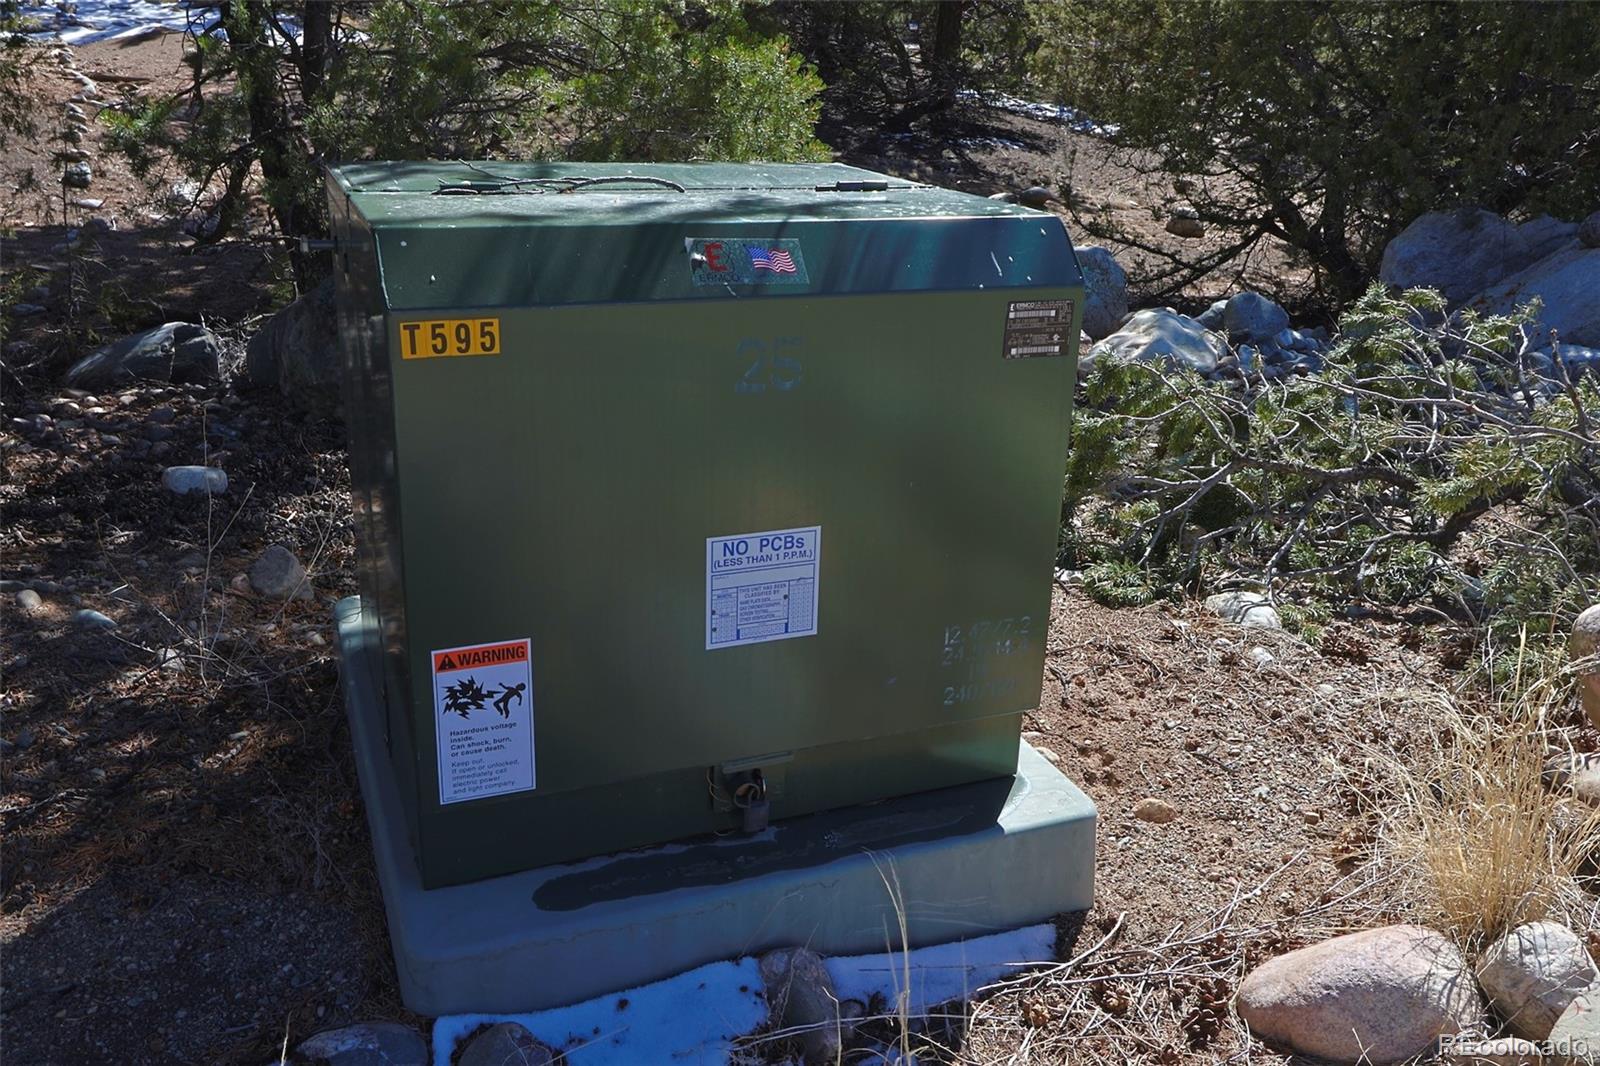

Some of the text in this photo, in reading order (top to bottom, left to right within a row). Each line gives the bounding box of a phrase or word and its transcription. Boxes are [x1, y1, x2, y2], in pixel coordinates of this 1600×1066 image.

[704, 242, 730, 272] E
[735, 336, 803, 393] 25
[723, 535, 805, 557] NO PCBs
[713, 549, 813, 570] (LESS THAN 1 P.P.M.)
[744, 590, 772, 599] CLASSIFIED
[457, 646, 526, 666] WARNING
[449, 722, 517, 737] Hazardous voltage
[450, 735, 474, 744] inside.
[450, 736, 512, 751] Can shock, burn,
[461, 748, 482, 756] cause
[484, 744, 506, 752] death.
[451, 758, 485, 769] Keep out.
[458, 766, 476, 775] open
[487, 759, 520, 769] unlocked,
[452, 769, 493, 781] immediately
[453, 775, 500, 788] electric power
[453, 787, 467, 795] and
[468, 783, 483, 793] light
